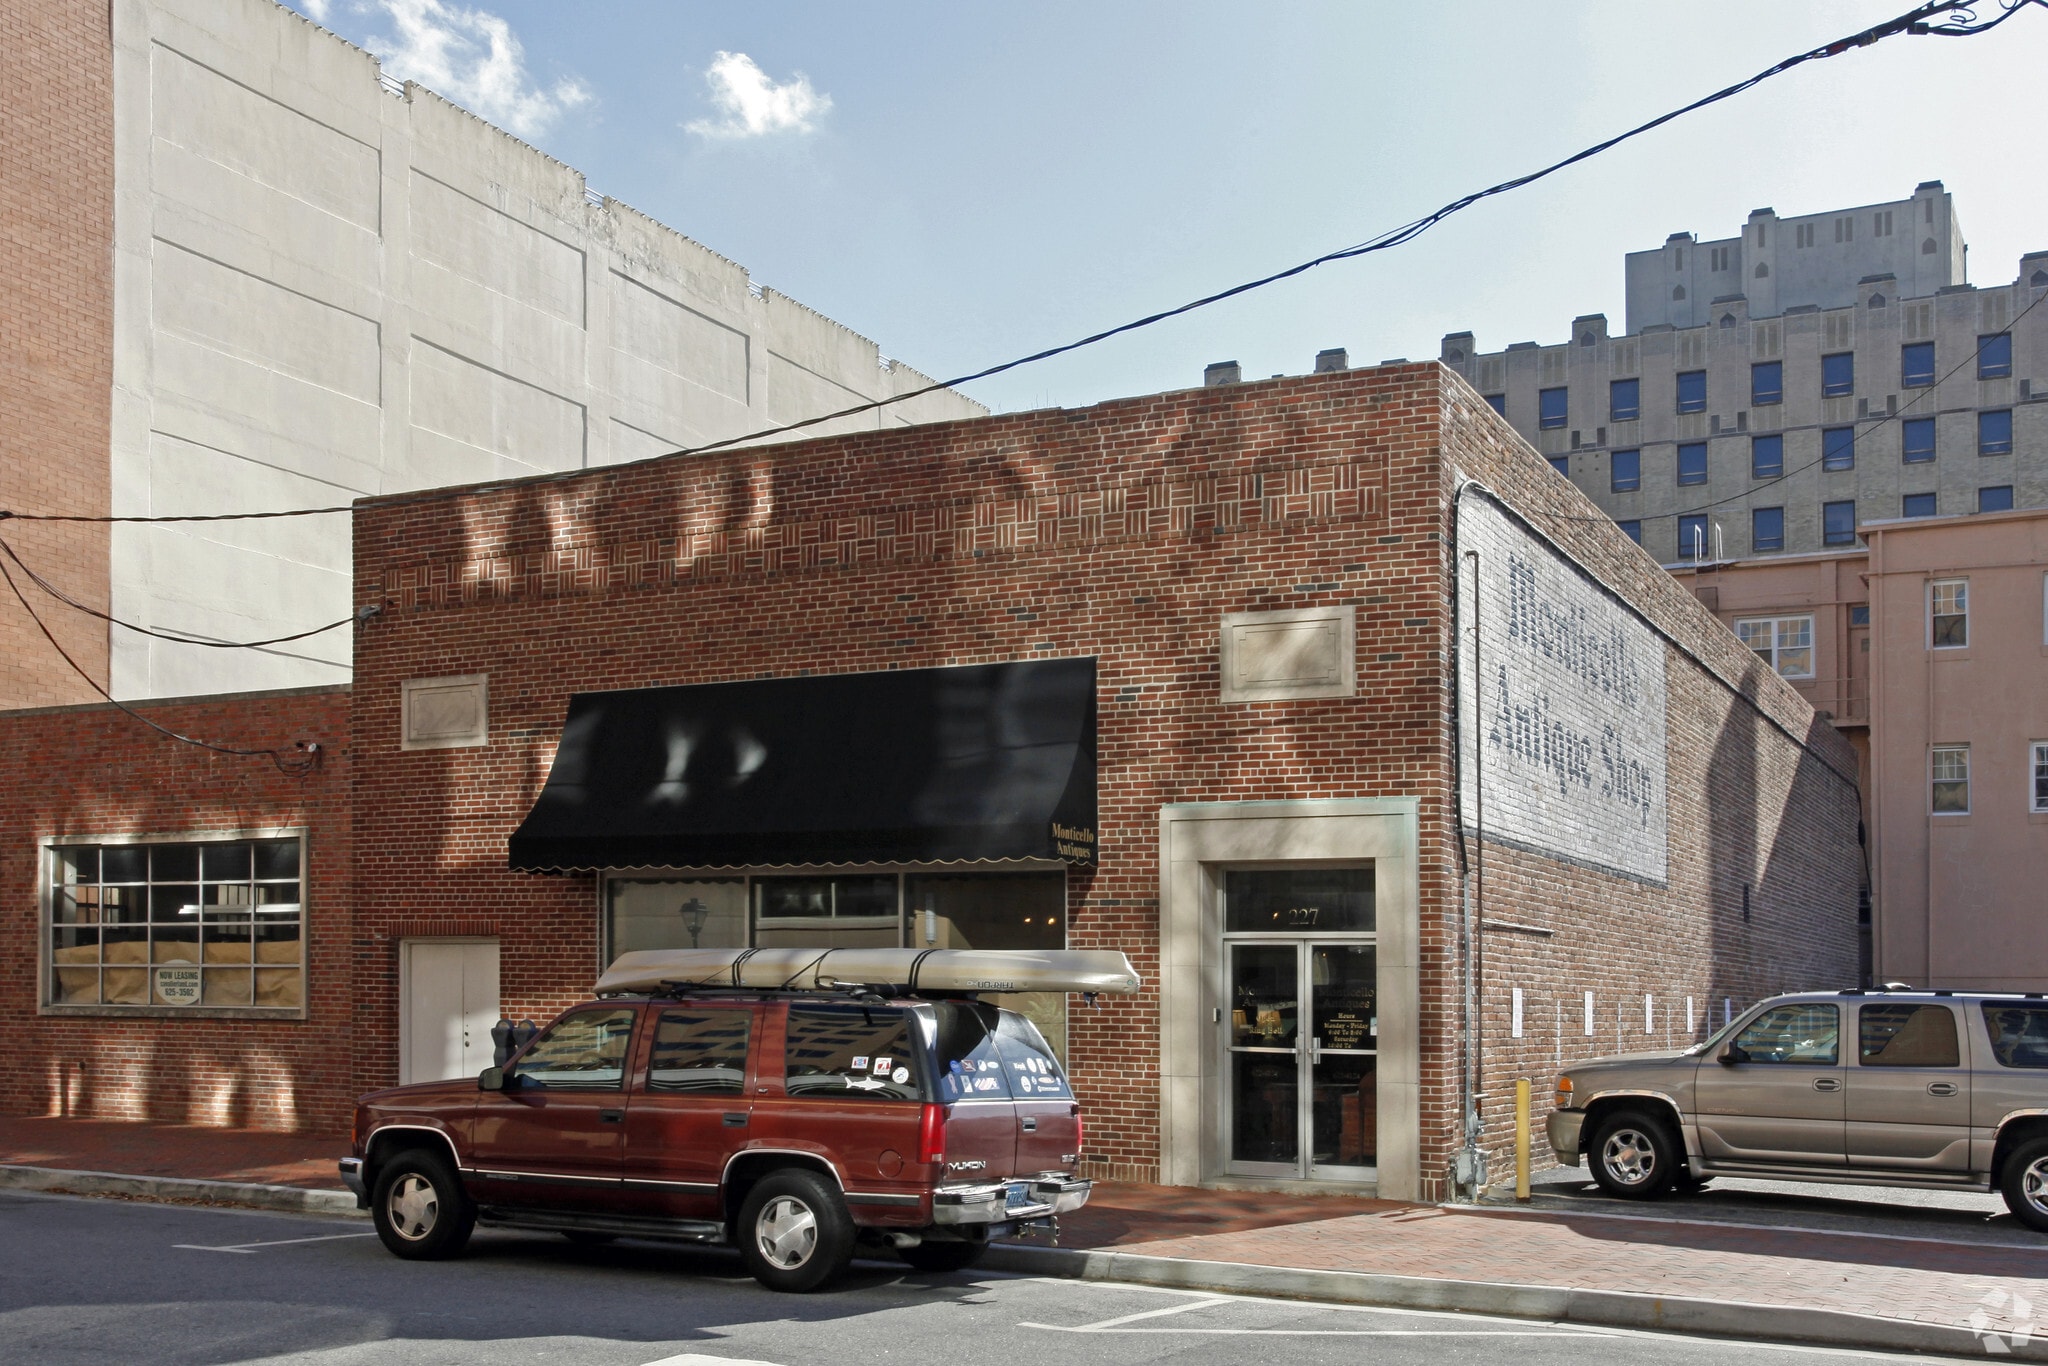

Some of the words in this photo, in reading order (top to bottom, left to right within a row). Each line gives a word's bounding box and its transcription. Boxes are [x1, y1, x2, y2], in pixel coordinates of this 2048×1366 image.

[1507, 551, 1638, 708] Monticello
[1488, 663, 1592, 797] Antique
[1600, 721, 1651, 829] Shop
[1052, 822, 1094, 843] Monticello
[1056, 840, 1091, 860] Antiques
[1288, 907, 1319, 925] 227
[159, 971, 173, 980] NOW
[174, 971, 199, 980] LEASING
[977, 981, 1015, 989] TARPON
[1323, 1022, 1346, 1030] Monday
[1350, 1022, 1369, 1030] Friday
[948, 1160, 987, 1171] YUKON
